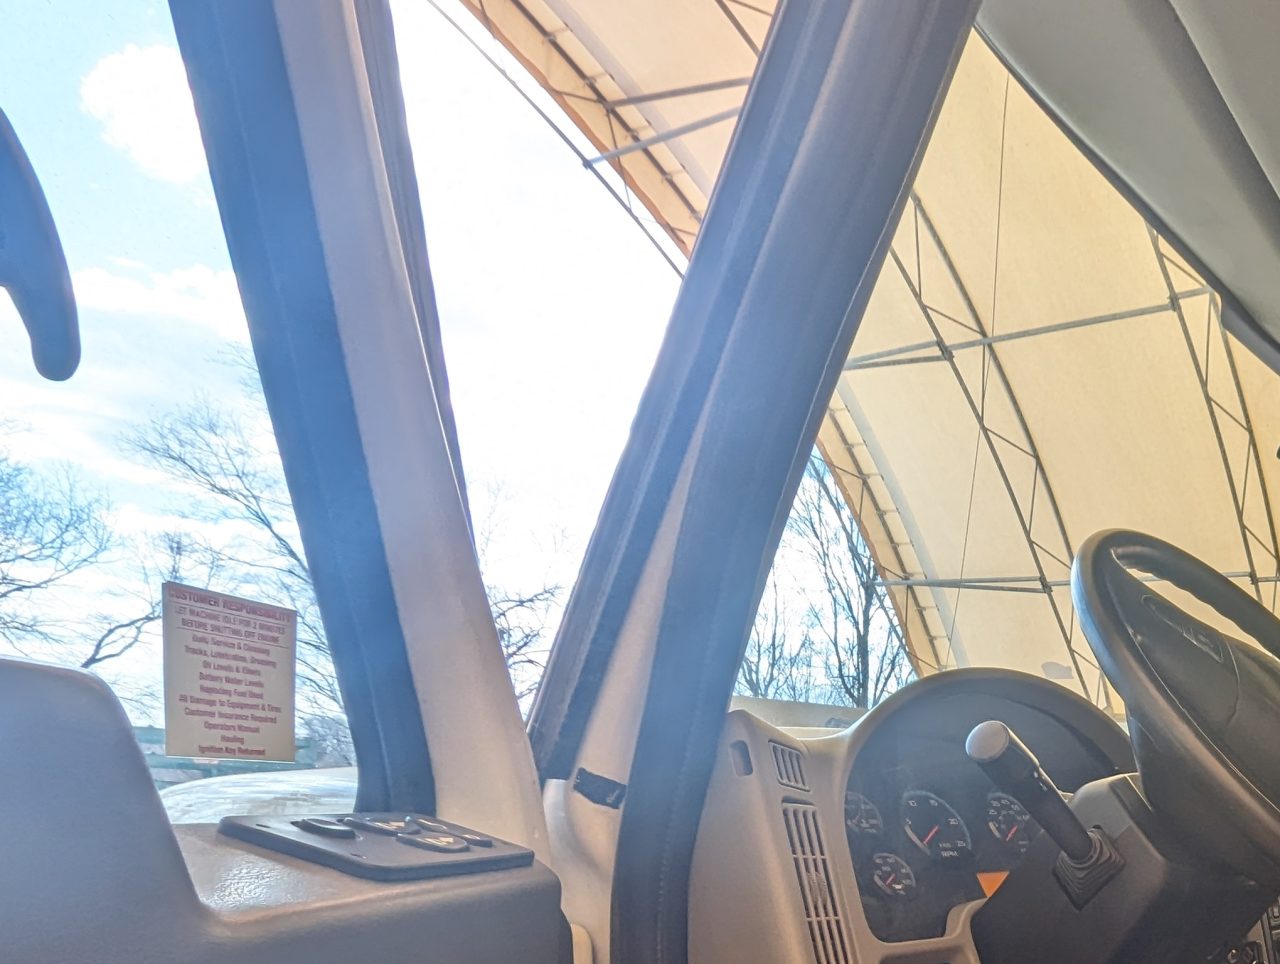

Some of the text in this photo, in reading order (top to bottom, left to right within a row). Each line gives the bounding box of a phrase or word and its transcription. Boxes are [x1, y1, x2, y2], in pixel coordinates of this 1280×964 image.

[169, 587, 220, 608] CUSTOMER
[189, 609, 221, 622] MACHINE
[182, 619, 208, 631] BEFORE
[211, 624, 242, 637] SHUTTING
[244, 631, 255, 639] OFF
[211, 638, 235, 648] Service
[213, 663, 233, 672] Levels
[200, 673, 264, 688] Battery Water Levels
[190, 696, 217, 707] Damage
[227, 701, 260, 711] Equipment
[218, 712, 249, 721] Insurance
[251, 715, 277, 724] Required
[238, 725, 260, 733] Manual
[221, 735, 244, 745] Hauling
[199, 746, 266, 756] Ignition Key Returned
